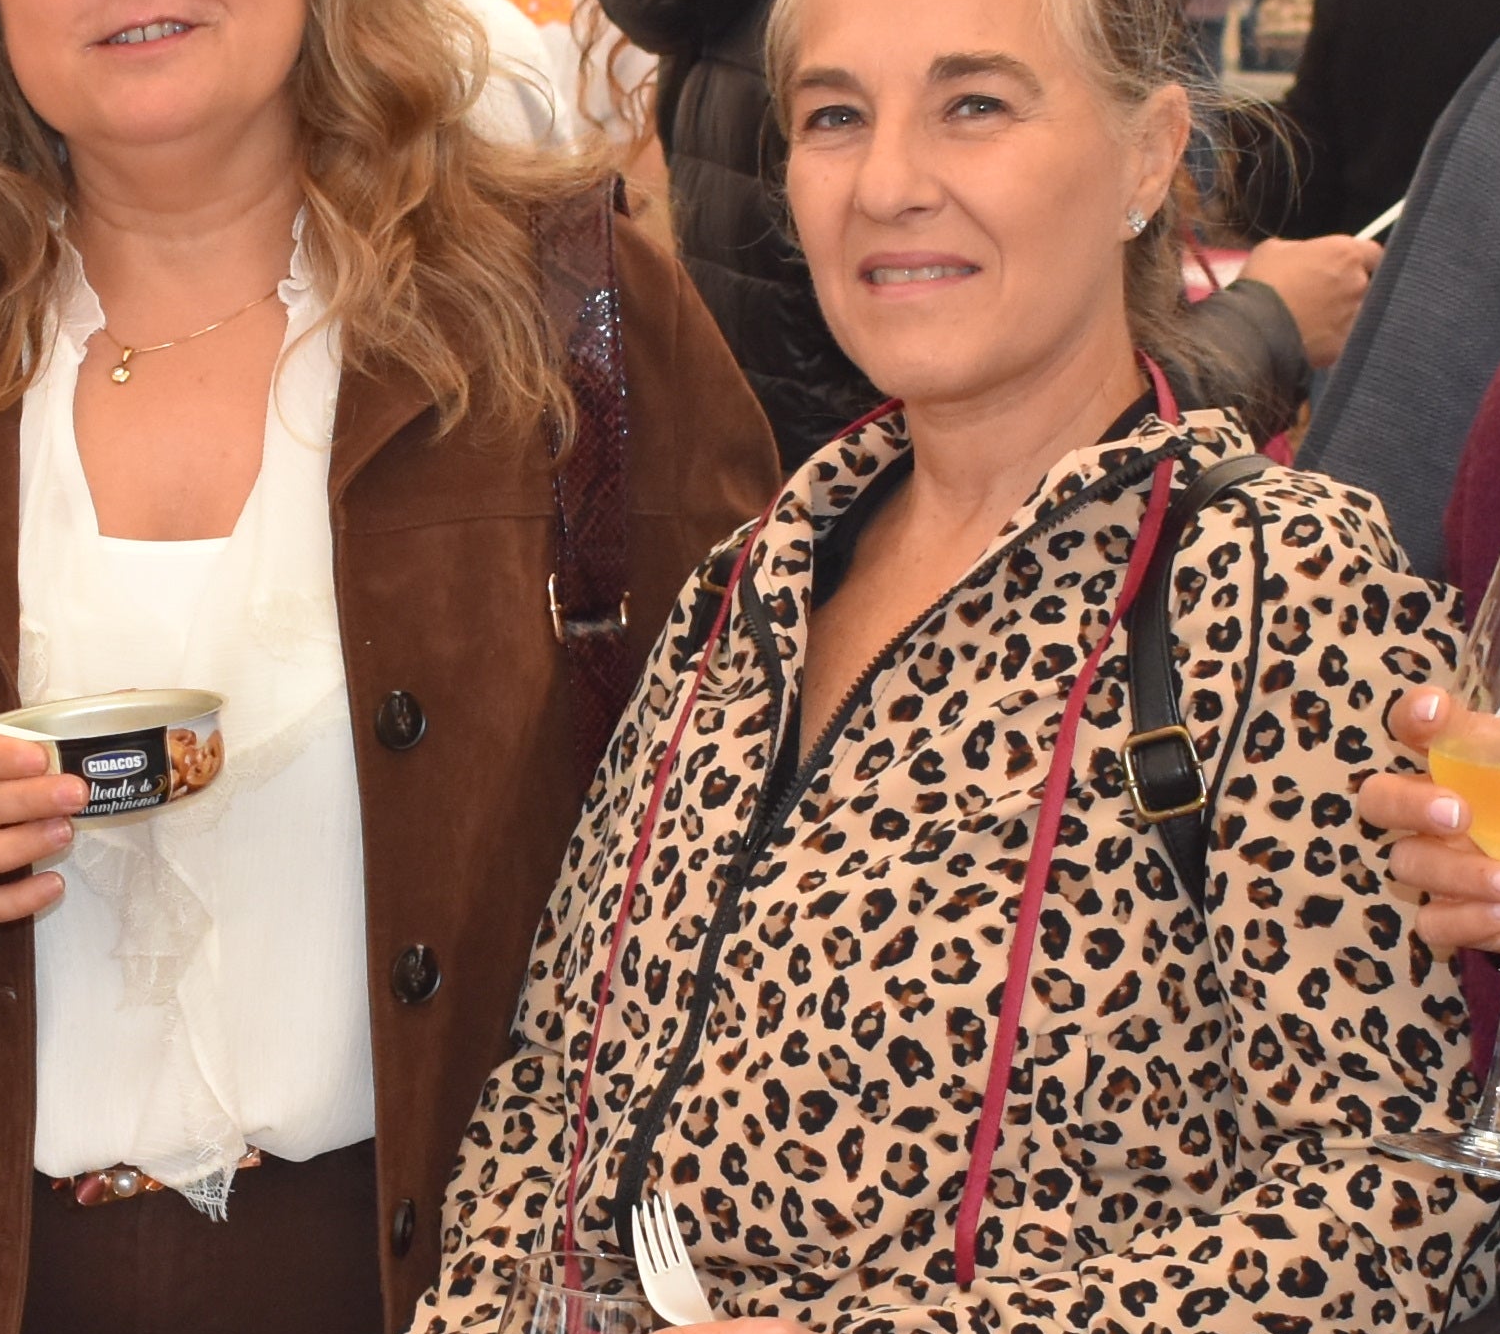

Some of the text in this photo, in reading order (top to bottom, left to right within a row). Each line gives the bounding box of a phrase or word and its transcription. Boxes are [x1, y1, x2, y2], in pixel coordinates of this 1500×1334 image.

[88, 755, 142, 773] CIDACOS
[90, 778, 153, 802] lteado de
[81, 793, 162, 815] hampiñones
